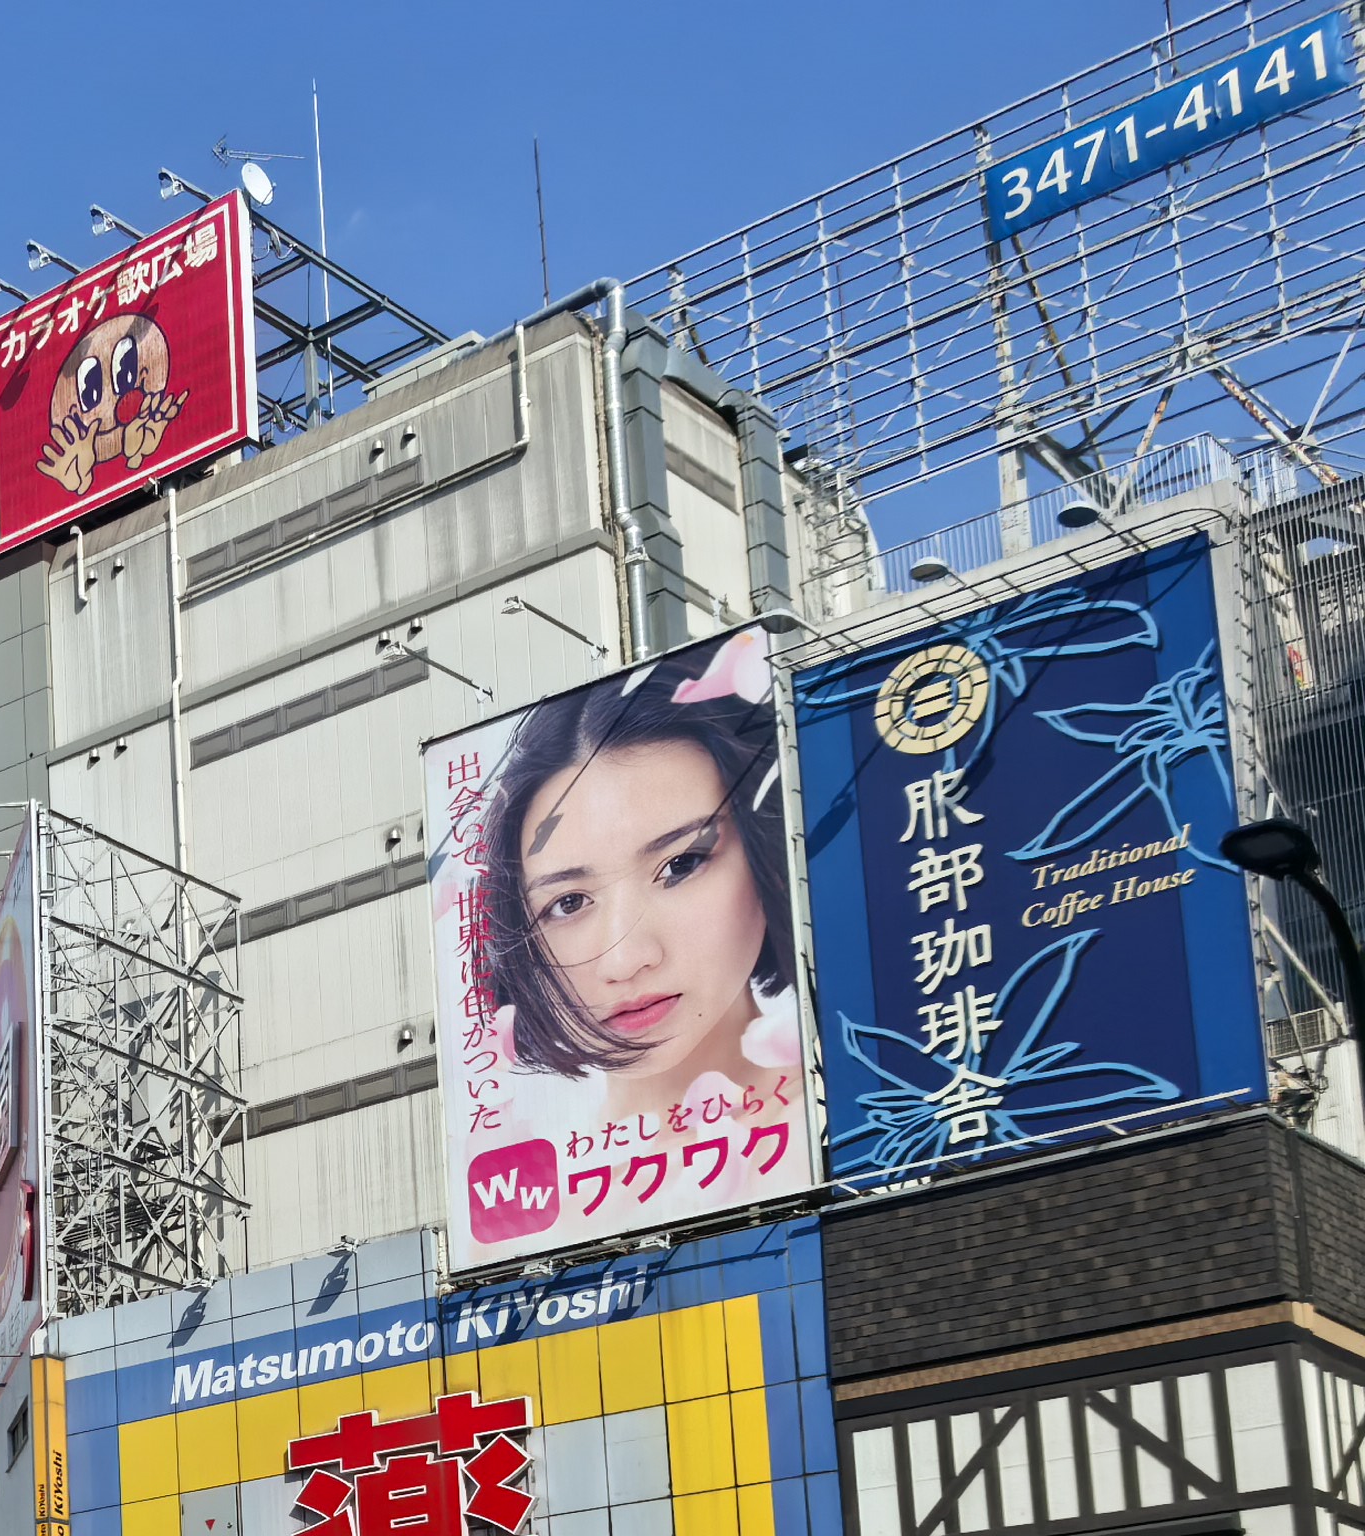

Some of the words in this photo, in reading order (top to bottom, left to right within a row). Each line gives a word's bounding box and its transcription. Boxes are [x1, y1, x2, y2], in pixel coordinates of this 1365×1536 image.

[1000, 28, 1327, 221] 3471-4141
[0, 222, 218, 369] カラオケ歌広場
[1020, 884, 1105, 932] Coffee
[1110, 863, 1196, 912] House
[1030, 822, 1192, 893] Traditional
[446, 751, 501, 1134] 出会いで、世界に色がついた
[566, 1075, 790, 1159] わたしをひらく
[568, 1122, 789, 1217] ワクワク
[171, 1319, 437, 1408] Matsumoto
